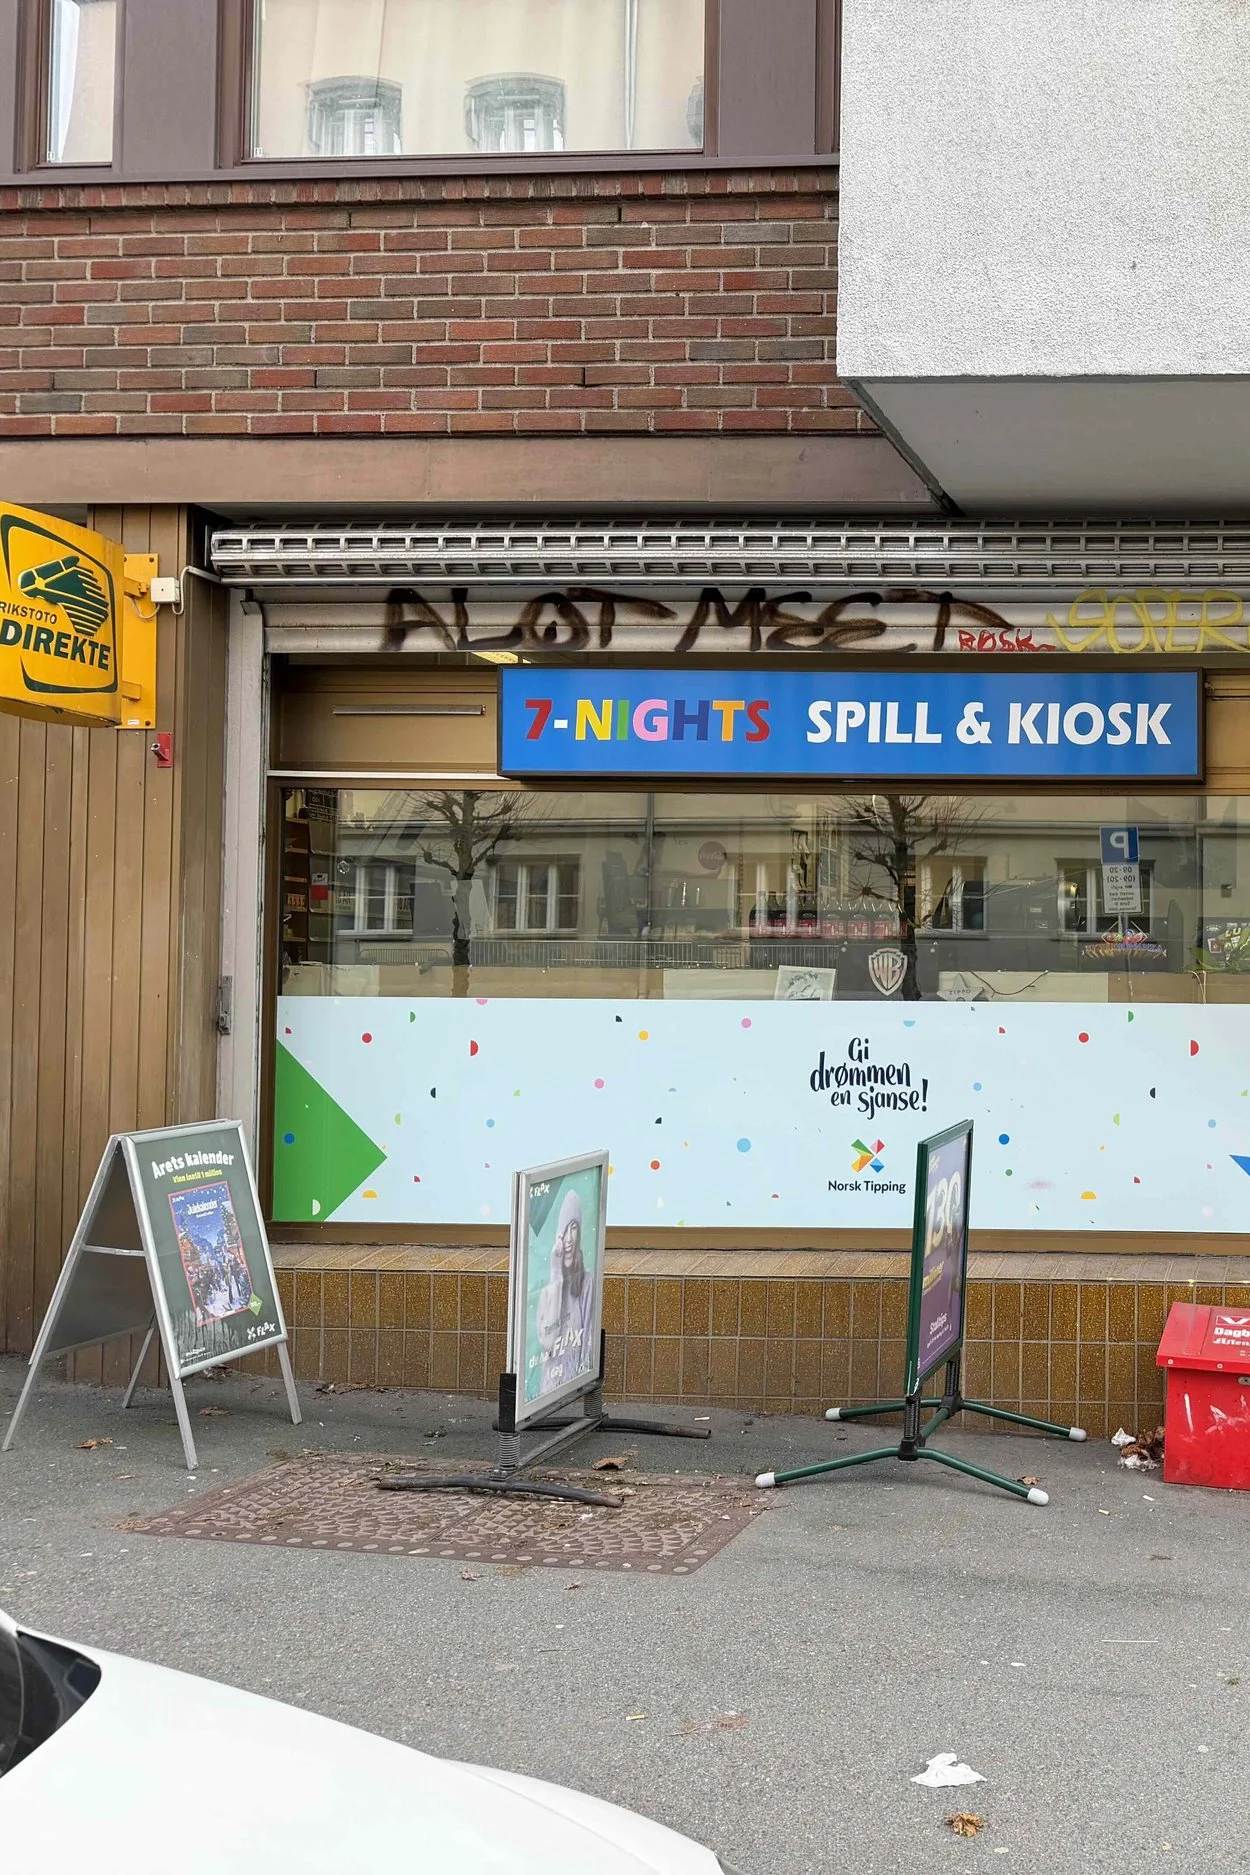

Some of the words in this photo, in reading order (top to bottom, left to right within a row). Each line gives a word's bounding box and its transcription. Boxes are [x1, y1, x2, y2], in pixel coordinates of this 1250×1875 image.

[0, 602, 57, 624] RIKSTOTO
[0, 618, 111, 671] DIREKTE
[525, 698, 770, 742] 7-NIGHTS
[806, 700, 942, 744] SPILL
[956, 701, 993, 745] &
[1007, 702, 1172, 746] KIOSK
[848, 1037, 869, 1063] Gi
[810, 1051, 911, 1092] drømmen
[831, 1089, 851, 1106] en
[857, 1078, 928, 1120] sjanse!
[184, 1151, 234, 1166] kalender
[828, 1181, 861, 1191] Norsk
[863, 1181, 906, 1194] Tipping
[257, 1322, 276, 1336] FLAX
[552, 1328, 584, 1358] FLAX
